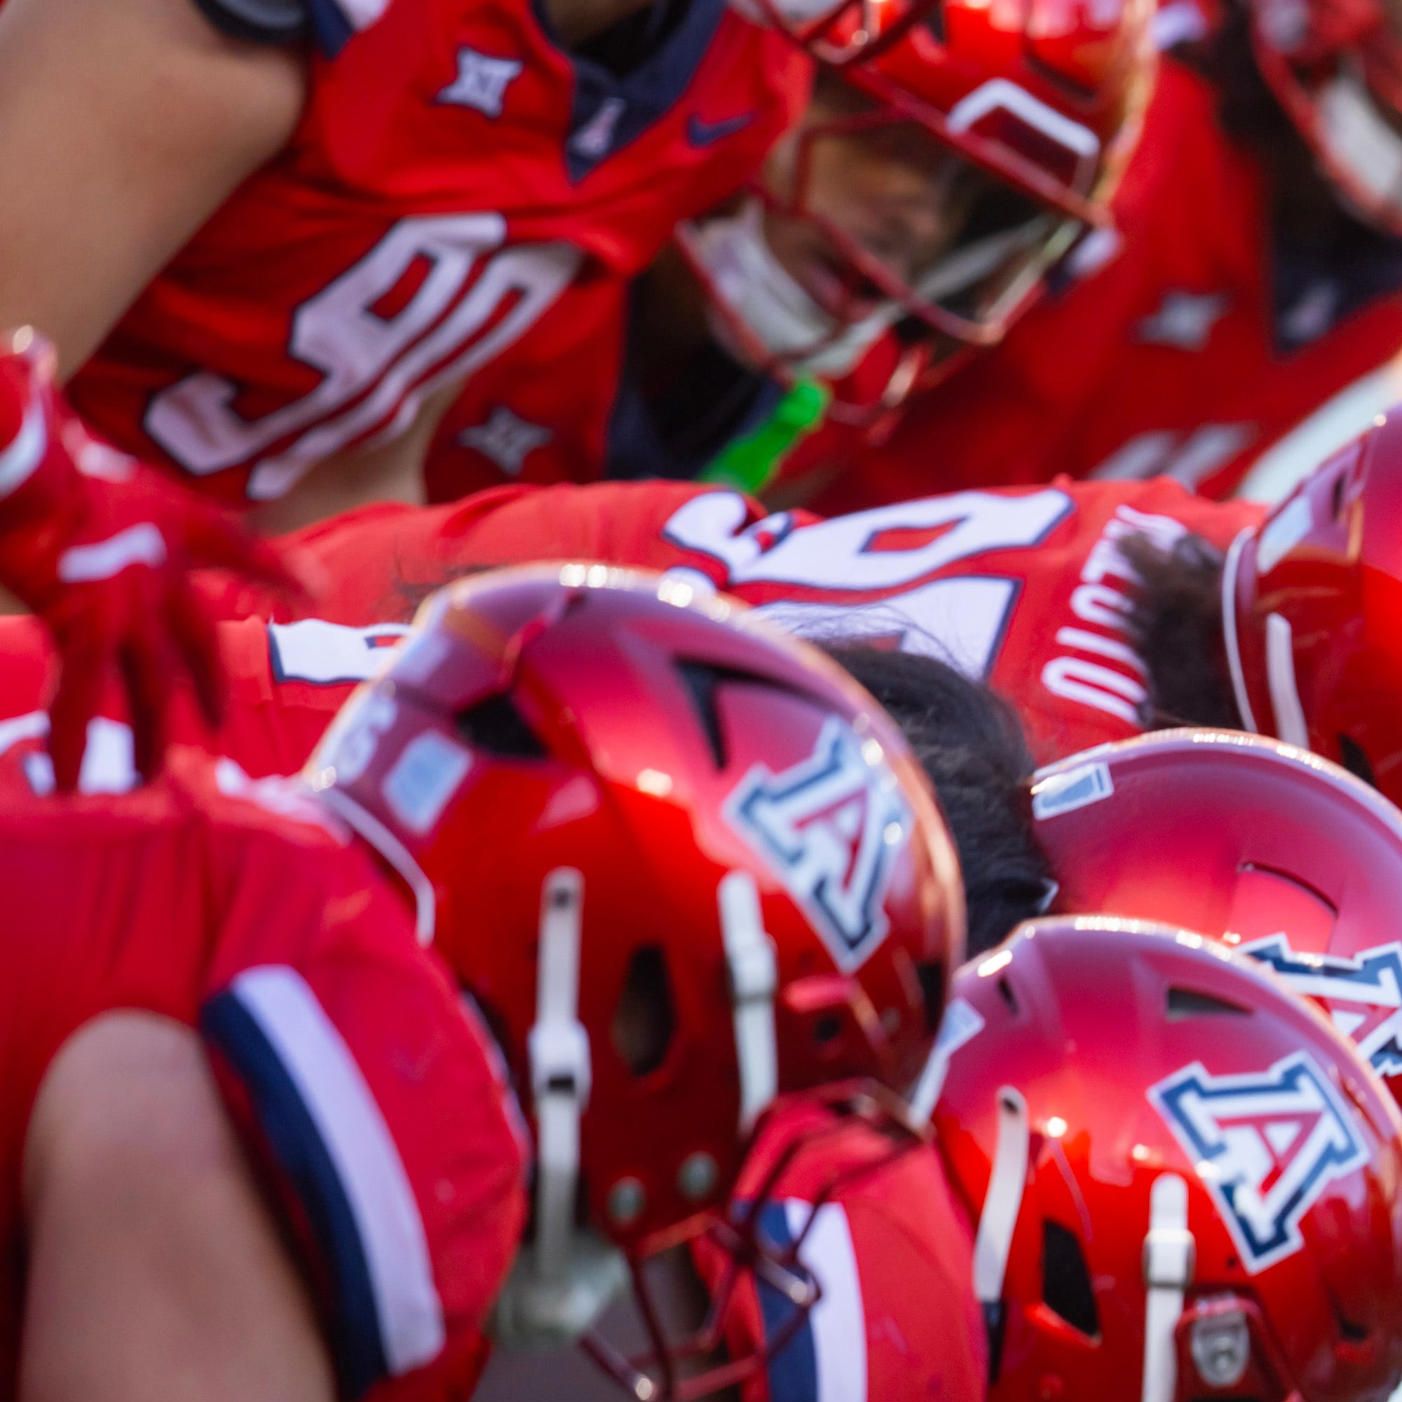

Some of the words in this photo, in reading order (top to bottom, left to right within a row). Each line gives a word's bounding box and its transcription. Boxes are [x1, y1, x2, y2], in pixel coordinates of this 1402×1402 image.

[143, 211, 585, 502] 90
[722, 714, 916, 974] A
[1146, 1050, 1372, 1275] A
